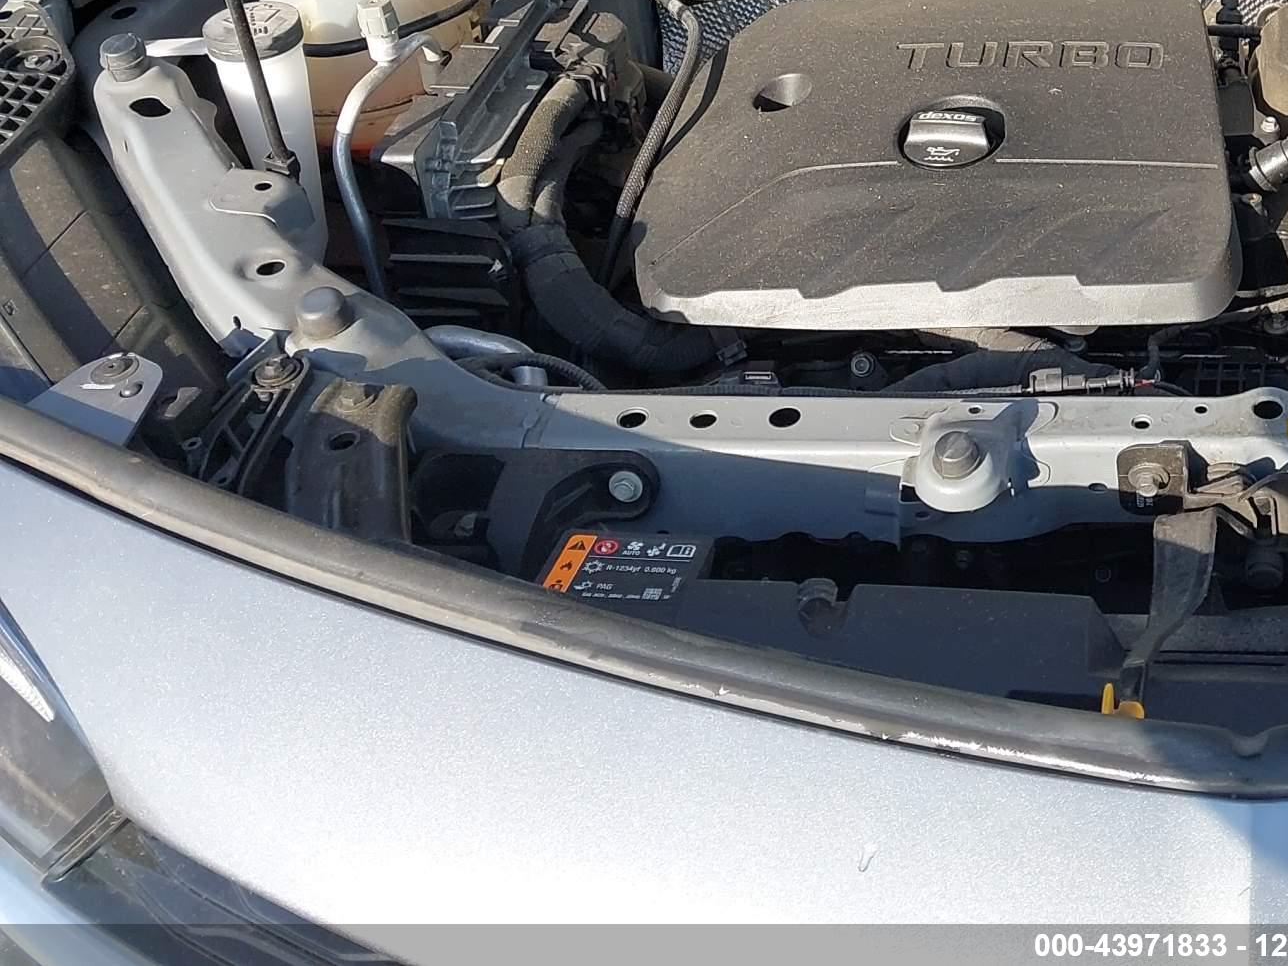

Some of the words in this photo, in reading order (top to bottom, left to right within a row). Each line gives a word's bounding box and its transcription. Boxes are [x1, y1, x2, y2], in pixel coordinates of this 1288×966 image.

[896, 40, 1165, 70] TURBO
[918, 111, 977, 122] dexos
[606, 564, 641, 573] R-1234yf
[666, 567, 677, 575] kg
